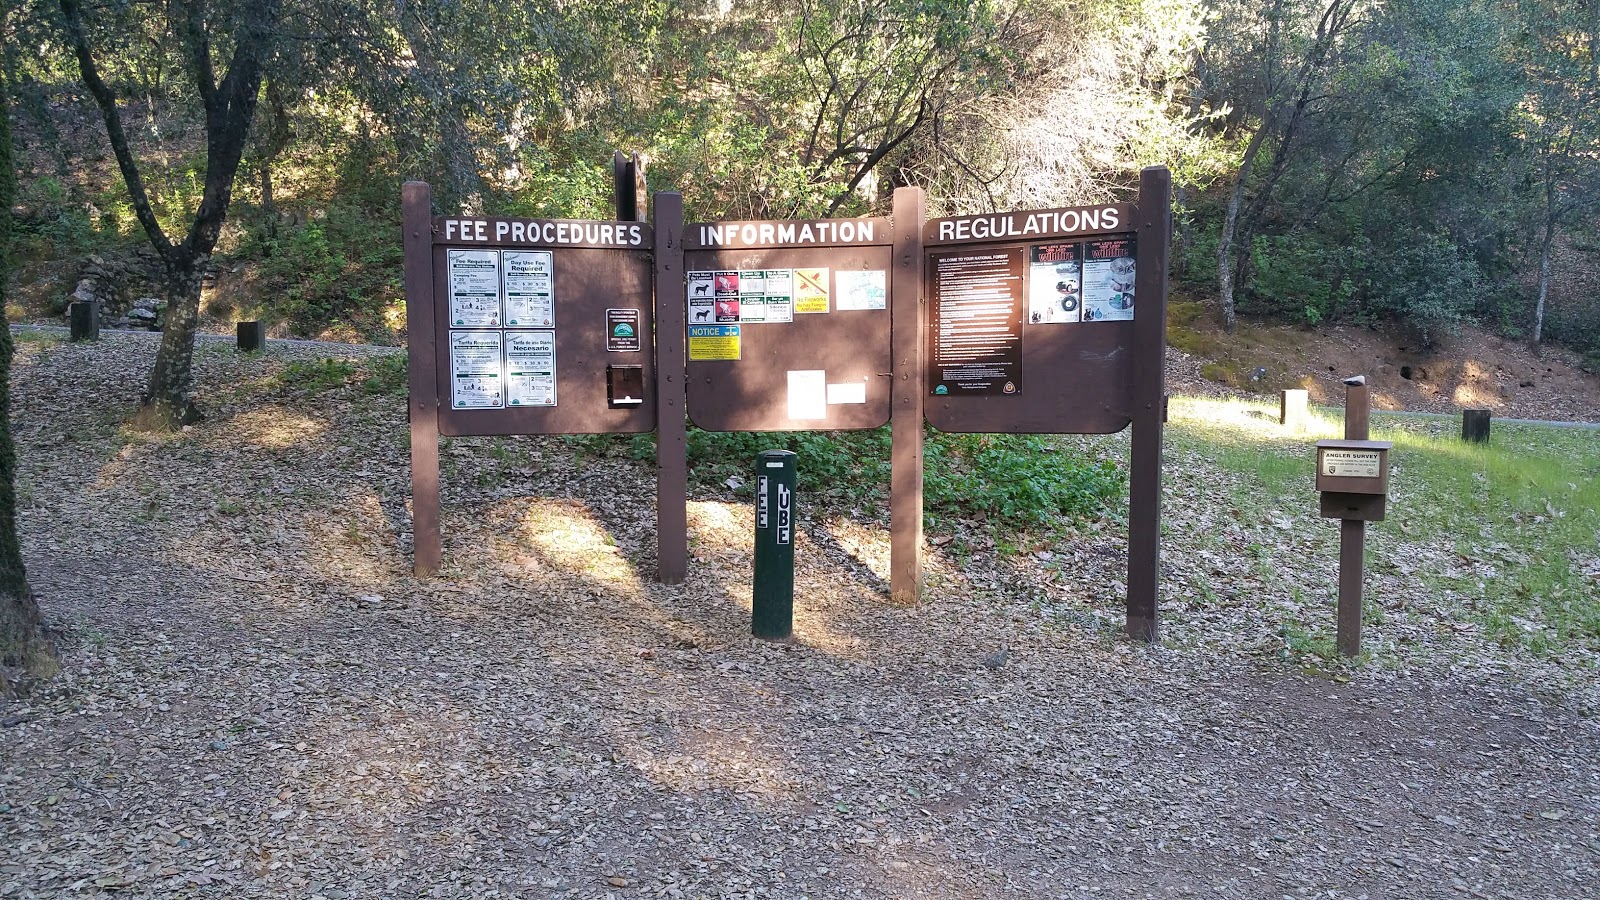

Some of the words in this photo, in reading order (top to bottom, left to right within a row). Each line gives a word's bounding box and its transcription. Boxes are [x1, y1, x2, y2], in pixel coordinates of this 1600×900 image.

[445, 220, 488, 241] FEE
[496, 222, 641, 245] PROCEDURES
[701, 222, 874, 246] INFORMATION
[939, 208, 1119, 241] REGULATIONS
[1039, 252, 1073, 261] wildfire
[1092, 249, 1128, 258] wildfire
